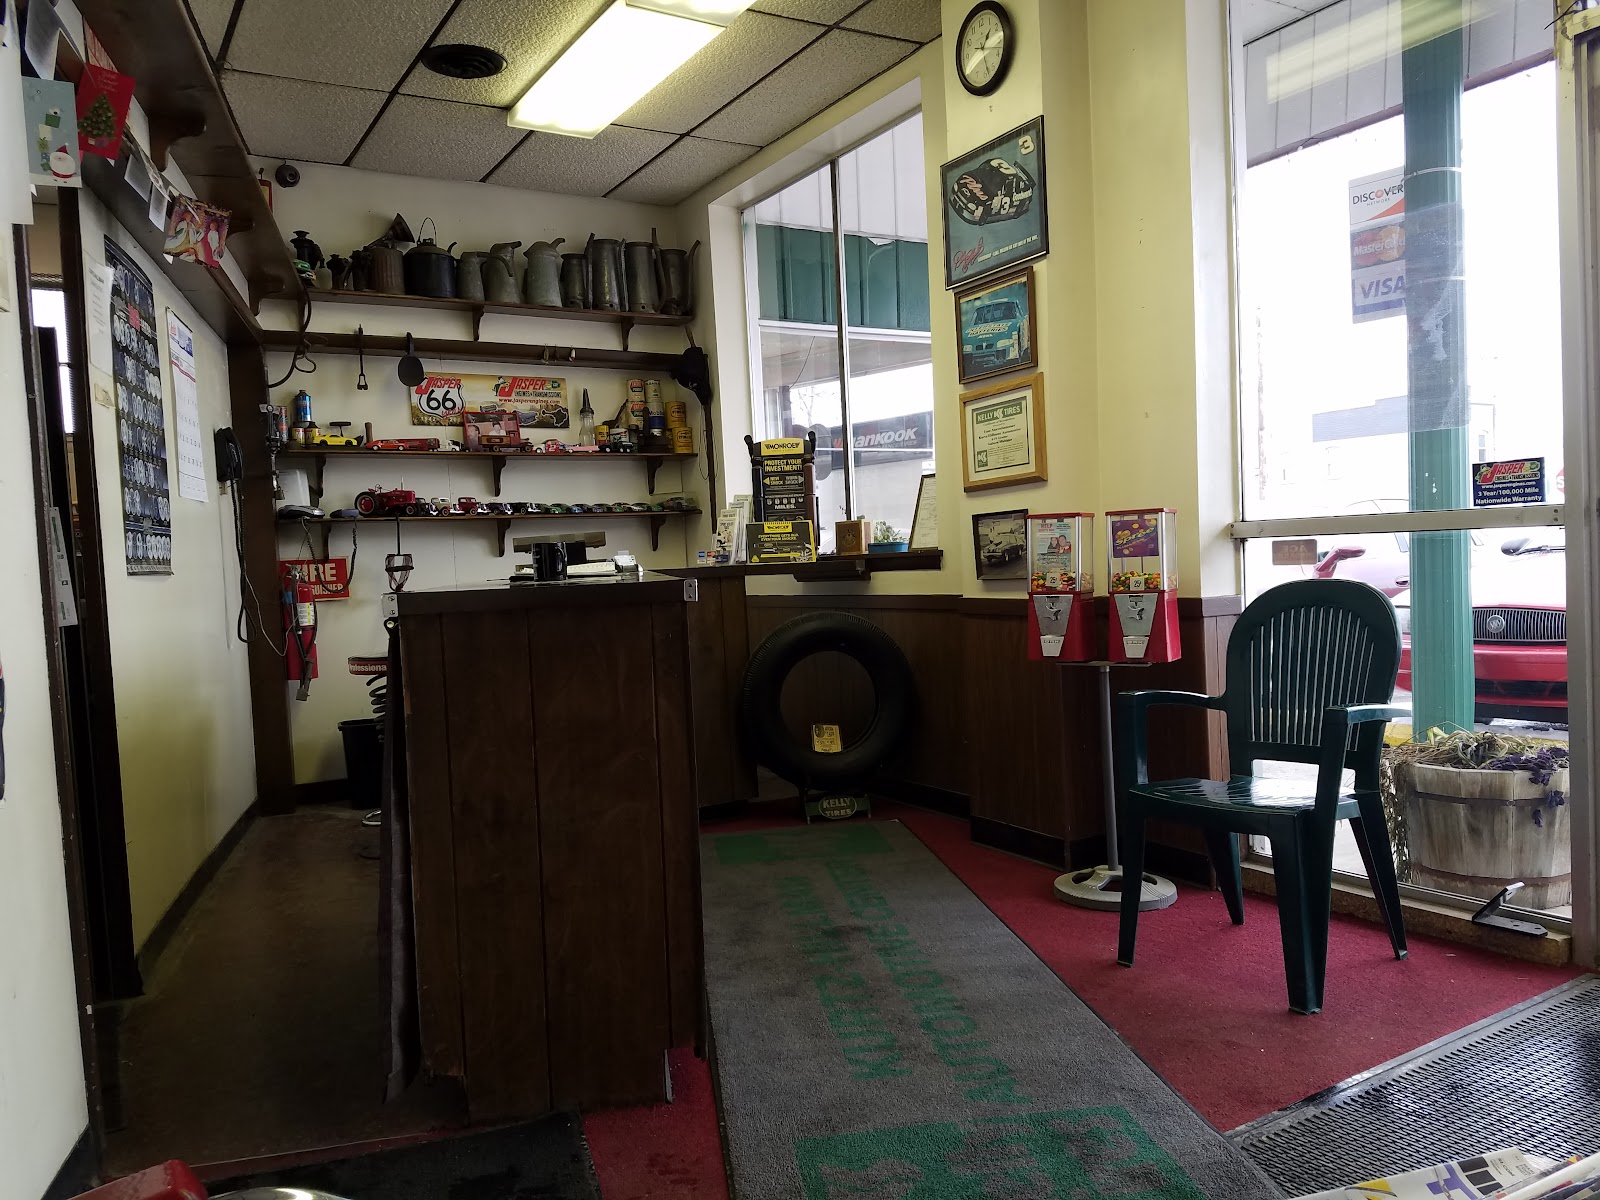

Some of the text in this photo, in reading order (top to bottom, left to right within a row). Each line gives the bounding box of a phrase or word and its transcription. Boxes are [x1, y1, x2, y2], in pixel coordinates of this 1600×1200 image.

[1018, 135, 1035, 155] 3
[1352, 183, 1404, 205] DISCOVER
[1000, 196, 1012, 215] 3
[1360, 275, 1406, 299] VISA
[415, 377, 462, 394] JASPER
[498, 377, 547, 397] JASPER
[426, 389, 457, 411] 66
[977, 405, 1021, 422] KELLY TIRES
[765, 442, 800, 450] MONROE
[764, 464, 803, 472] INVESTMENT!
[1480, 462, 1525, 483] JASPER
[1481, 481, 1536, 489] www.jasperengines.com
[1483, 488, 1524, 497] Year/100,000
[1475, 495, 1542, 505] Nationwide Warranty
[822, 797, 851, 809] KELLY
[825, 808, 852, 817] TIRES
